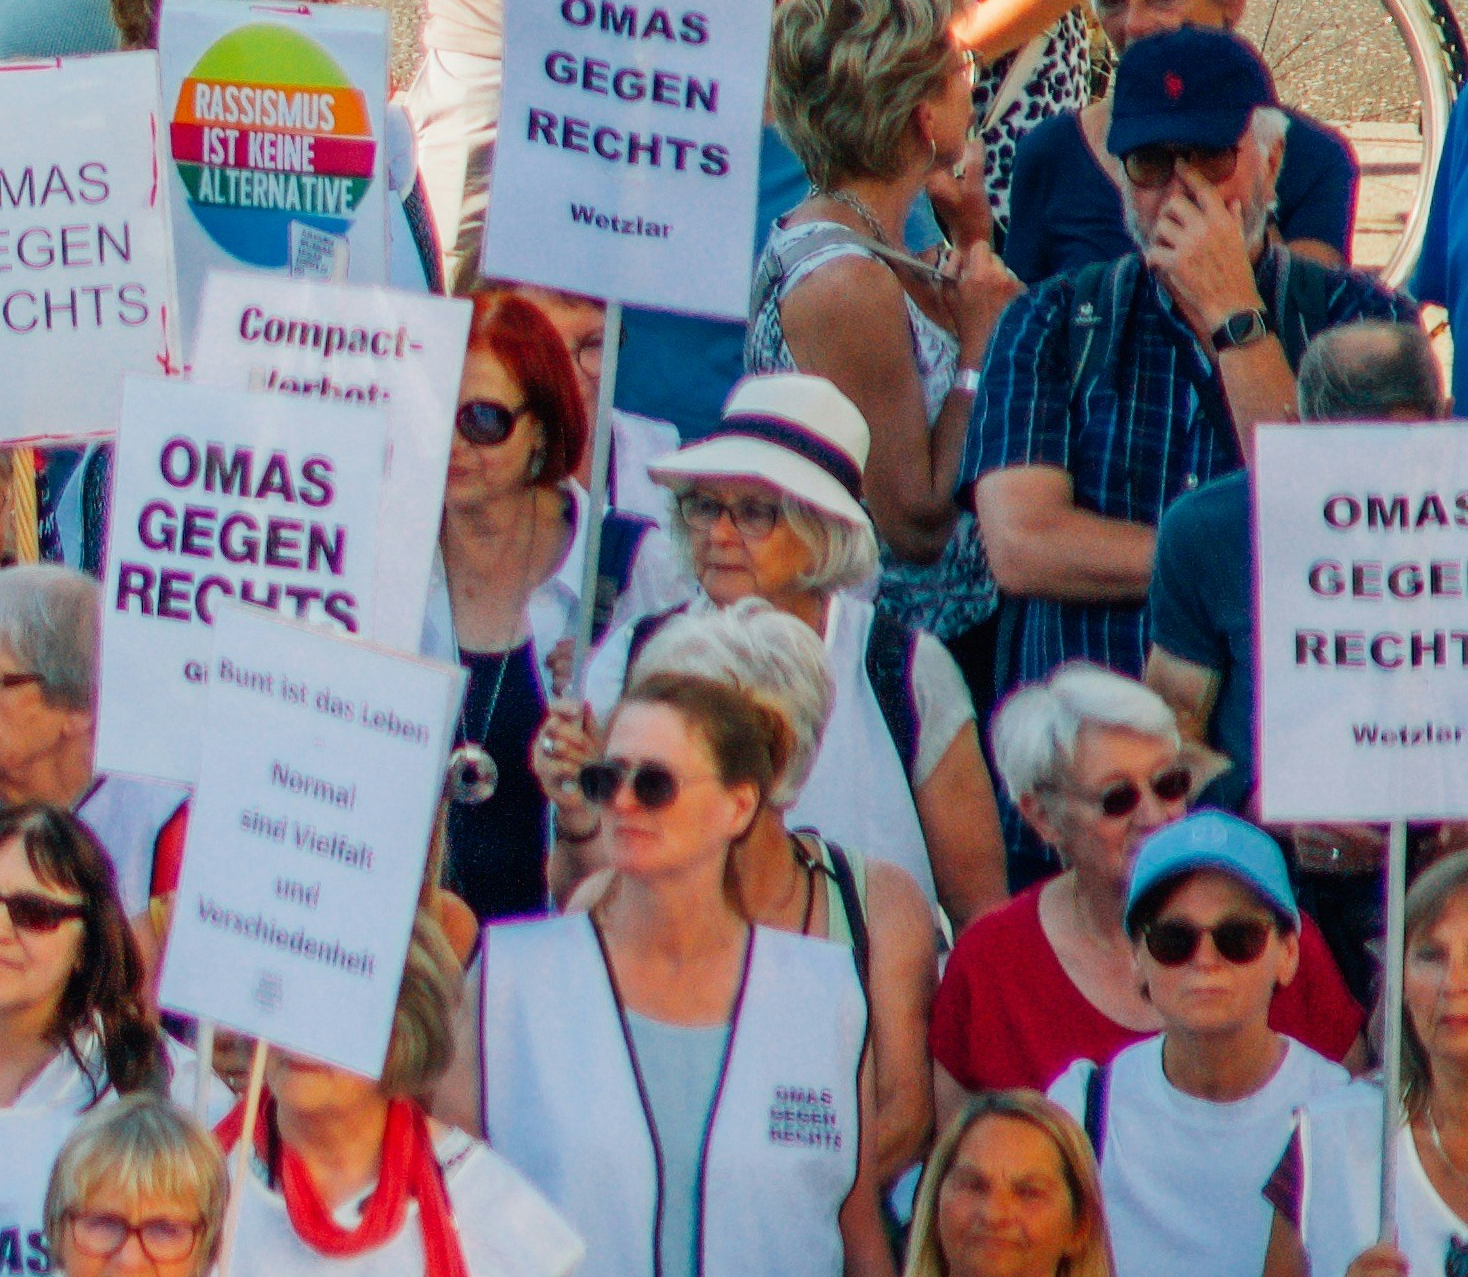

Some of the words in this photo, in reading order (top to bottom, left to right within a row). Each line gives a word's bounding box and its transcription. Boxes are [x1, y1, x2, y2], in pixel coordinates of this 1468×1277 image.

[195, 81, 336, 131] RASSISMUS
[545, 49, 720, 114] GEGEN
[202, 128, 237, 164] IST
[248, 132, 315, 174] KEINE
[527, 106, 732, 178] RECHTS
[198, 171, 357, 216] ALTERNATIVE
[570, 201, 674, 240] Wetzlar
[238, 305, 425, 360] Compact-
[159, 436, 337, 509] OMAS
[135, 498, 348, 577] GEGEN
[1308, 559, 1468, 601] GEGE
[218, 658, 275, 695] Bunt
[279, 677, 310, 707] ist
[314, 687, 355, 722] das
[360, 702, 431, 746] Leben
[1352, 722, 1463, 747] Wetzlar
[270, 760, 358, 812] Normal
[240, 808, 287, 843] sind
[293, 822, 375, 872] Vielfalt
[275, 878, 320, 910] und
[197, 896, 376, 979] Verschiedenheit
